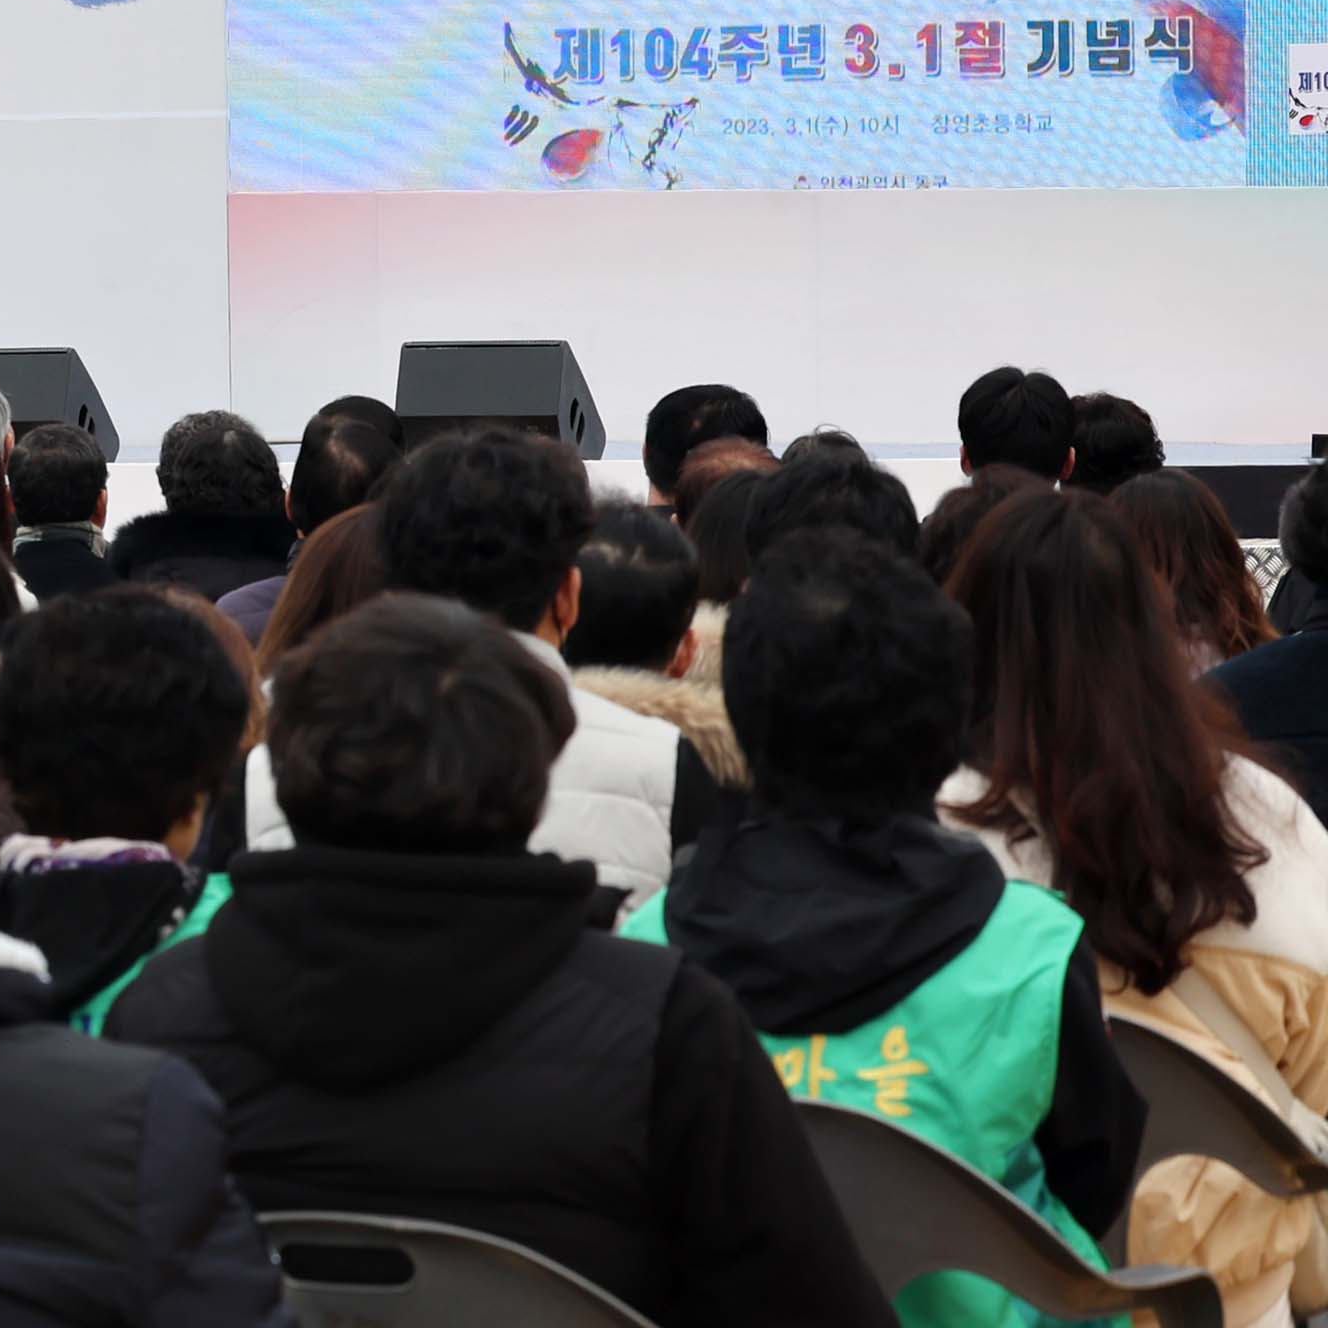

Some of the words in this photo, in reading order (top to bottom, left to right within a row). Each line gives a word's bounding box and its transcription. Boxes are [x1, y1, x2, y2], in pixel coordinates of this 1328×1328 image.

[552, 22, 828, 84] 제104주년
[843, 18, 1007, 82] 3.1절
[1026, 15, 1195, 79] 기념식
[859, 116, 900, 134] 10시
[932, 114, 1056, 135] 창영초등학교
